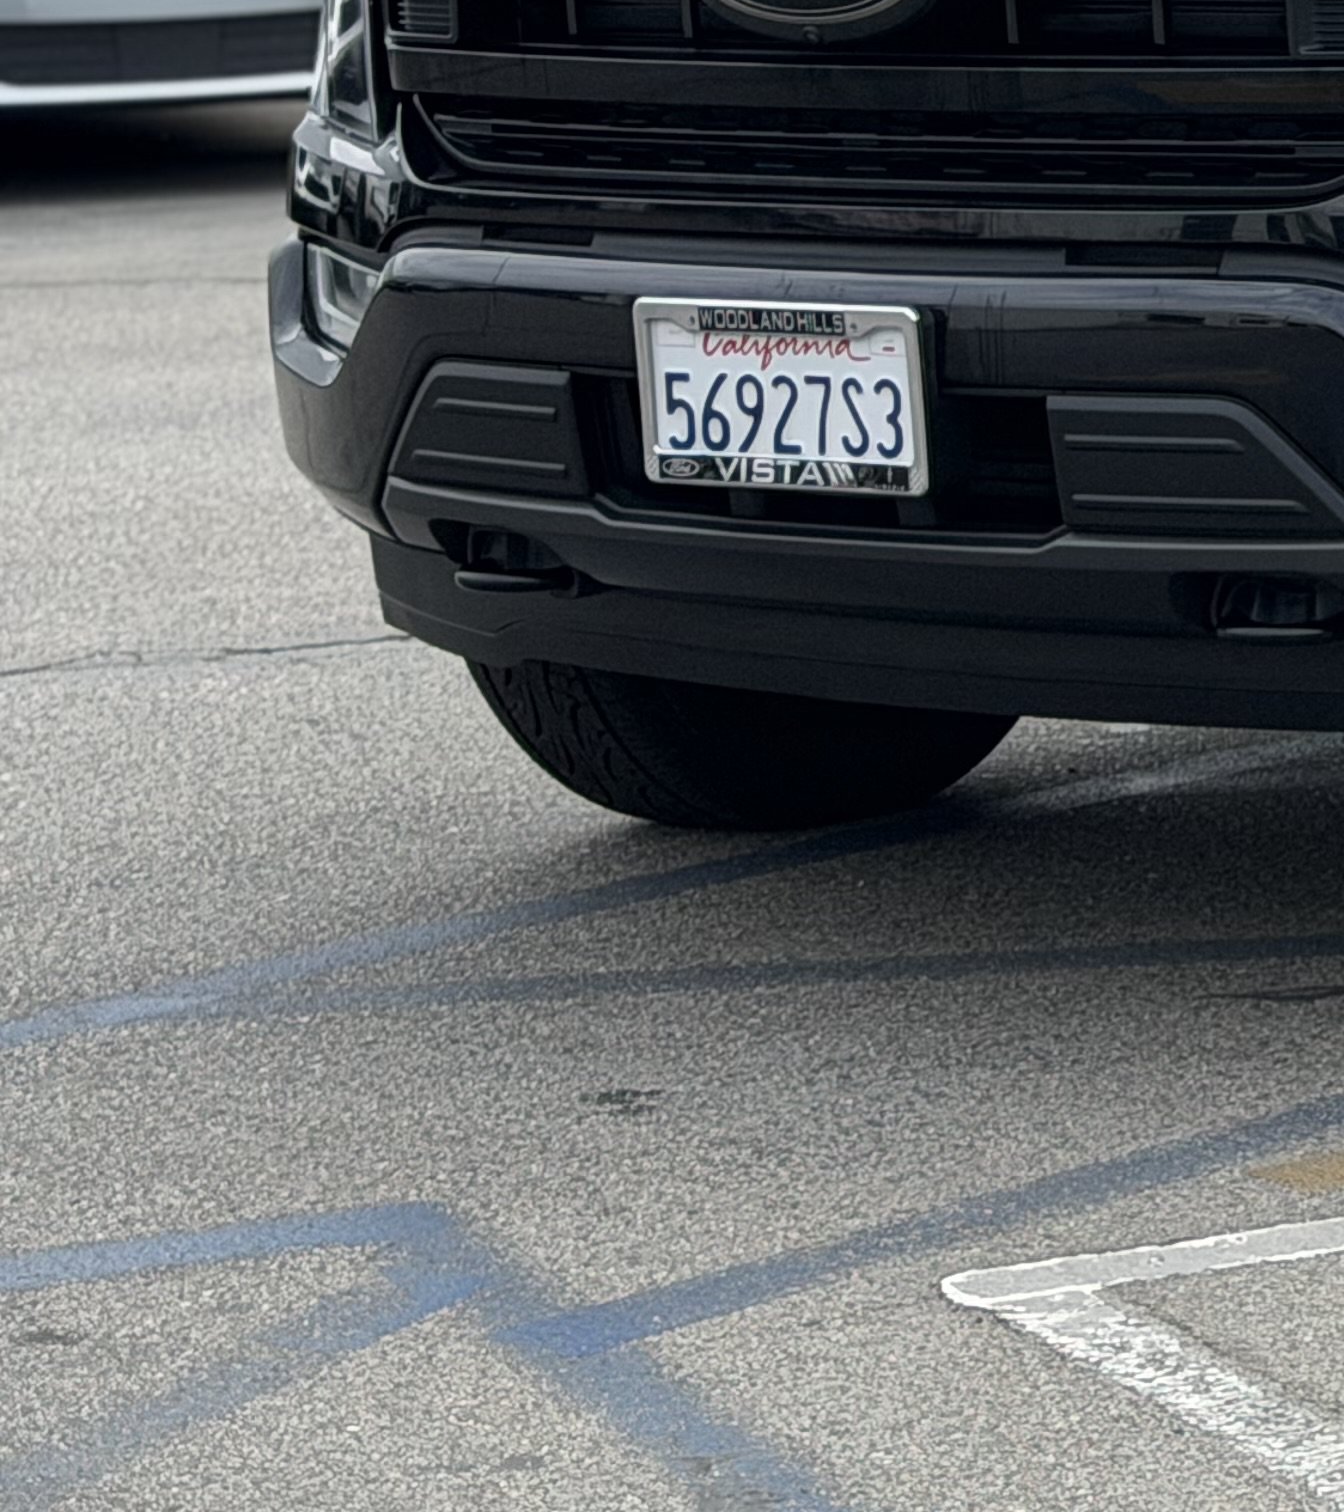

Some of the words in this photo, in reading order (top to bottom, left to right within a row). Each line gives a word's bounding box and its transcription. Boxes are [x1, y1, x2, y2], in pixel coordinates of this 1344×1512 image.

[699, 309, 794, 333] WOODLAND
[796, 312, 845, 335] HILLS
[703, 333, 871, 371] California
[664, 372, 904, 459] 56927S3
[715, 457, 825, 487] VISTA
